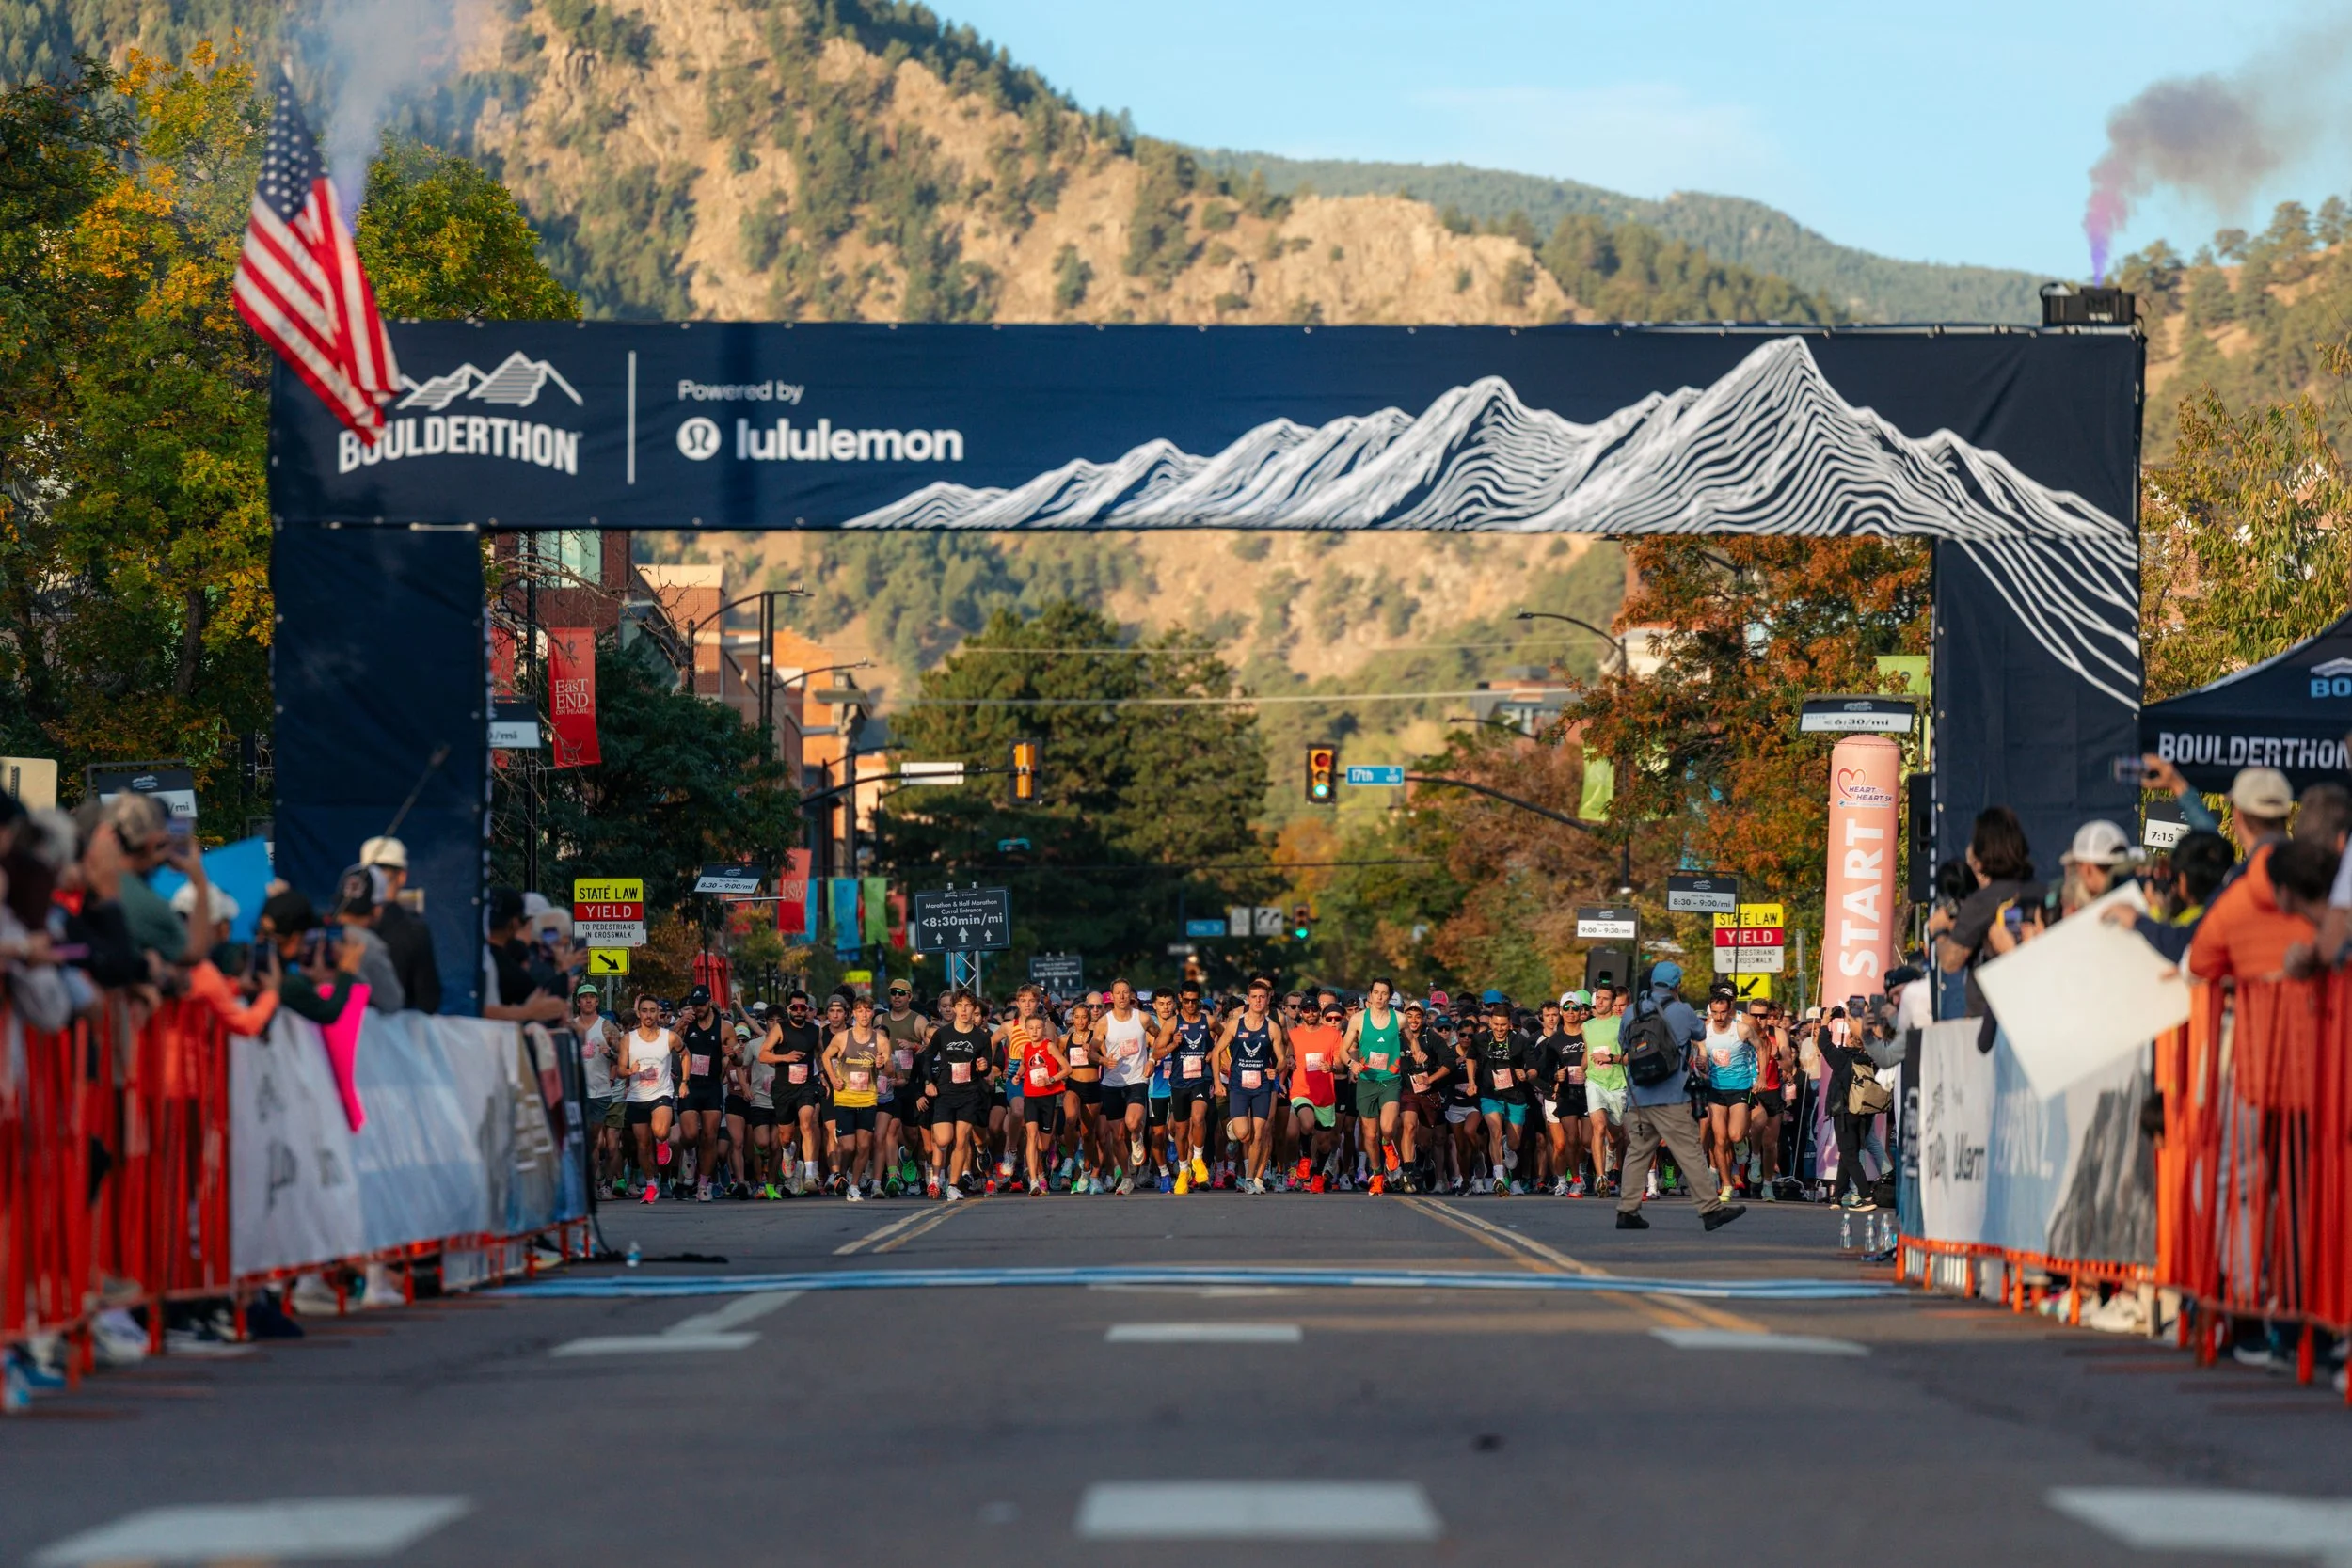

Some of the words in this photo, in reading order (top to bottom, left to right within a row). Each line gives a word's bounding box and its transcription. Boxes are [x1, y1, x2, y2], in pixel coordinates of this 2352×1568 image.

[677, 379, 773, 402] Powered
[776, 379, 804, 405] by
[736, 418, 964, 461] lululemon
[556, 693, 589, 711] END
[2158, 732, 2351, 770] BOULDERTHON
[1351, 768, 1374, 782] 17th
[2151, 831, 2175, 843] 7:15
[579, 887, 611, 900] STATE
[614, 887, 638, 900] LAW
[1839, 818, 1884, 978] START
[925, 901, 951, 910] Marathon
[1699, 899, 1731, 908] 9:00/mi
[585, 905, 632, 918] YIELD
[922, 912, 1004, 927] <8:30min/mi
[1755, 912, 1778, 926] LAW
[582, 923, 591, 931] TO
[592, 923, 636, 931] PEDESTRIANS
[1725, 930, 1773, 944] YIELD
